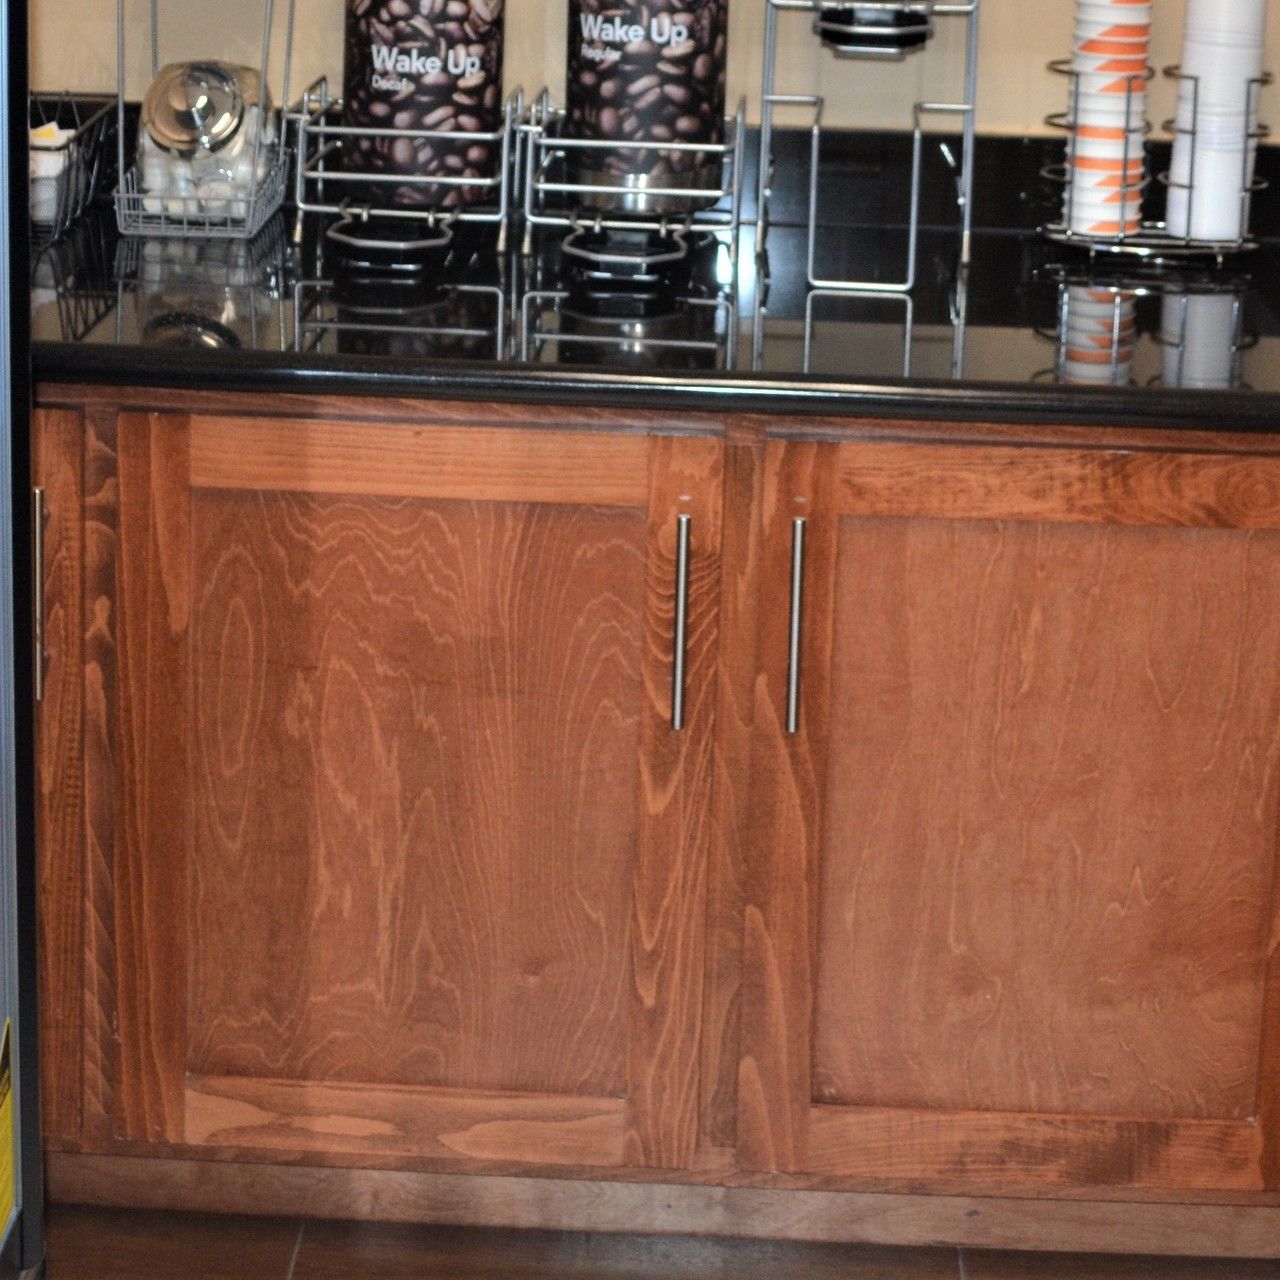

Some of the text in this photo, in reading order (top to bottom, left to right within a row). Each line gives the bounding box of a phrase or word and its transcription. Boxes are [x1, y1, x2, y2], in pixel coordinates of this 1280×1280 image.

[581, 14, 689, 51] Wake Up
[371, 44, 481, 81] Wake Up
[372, 74, 408, 93] Decaf
